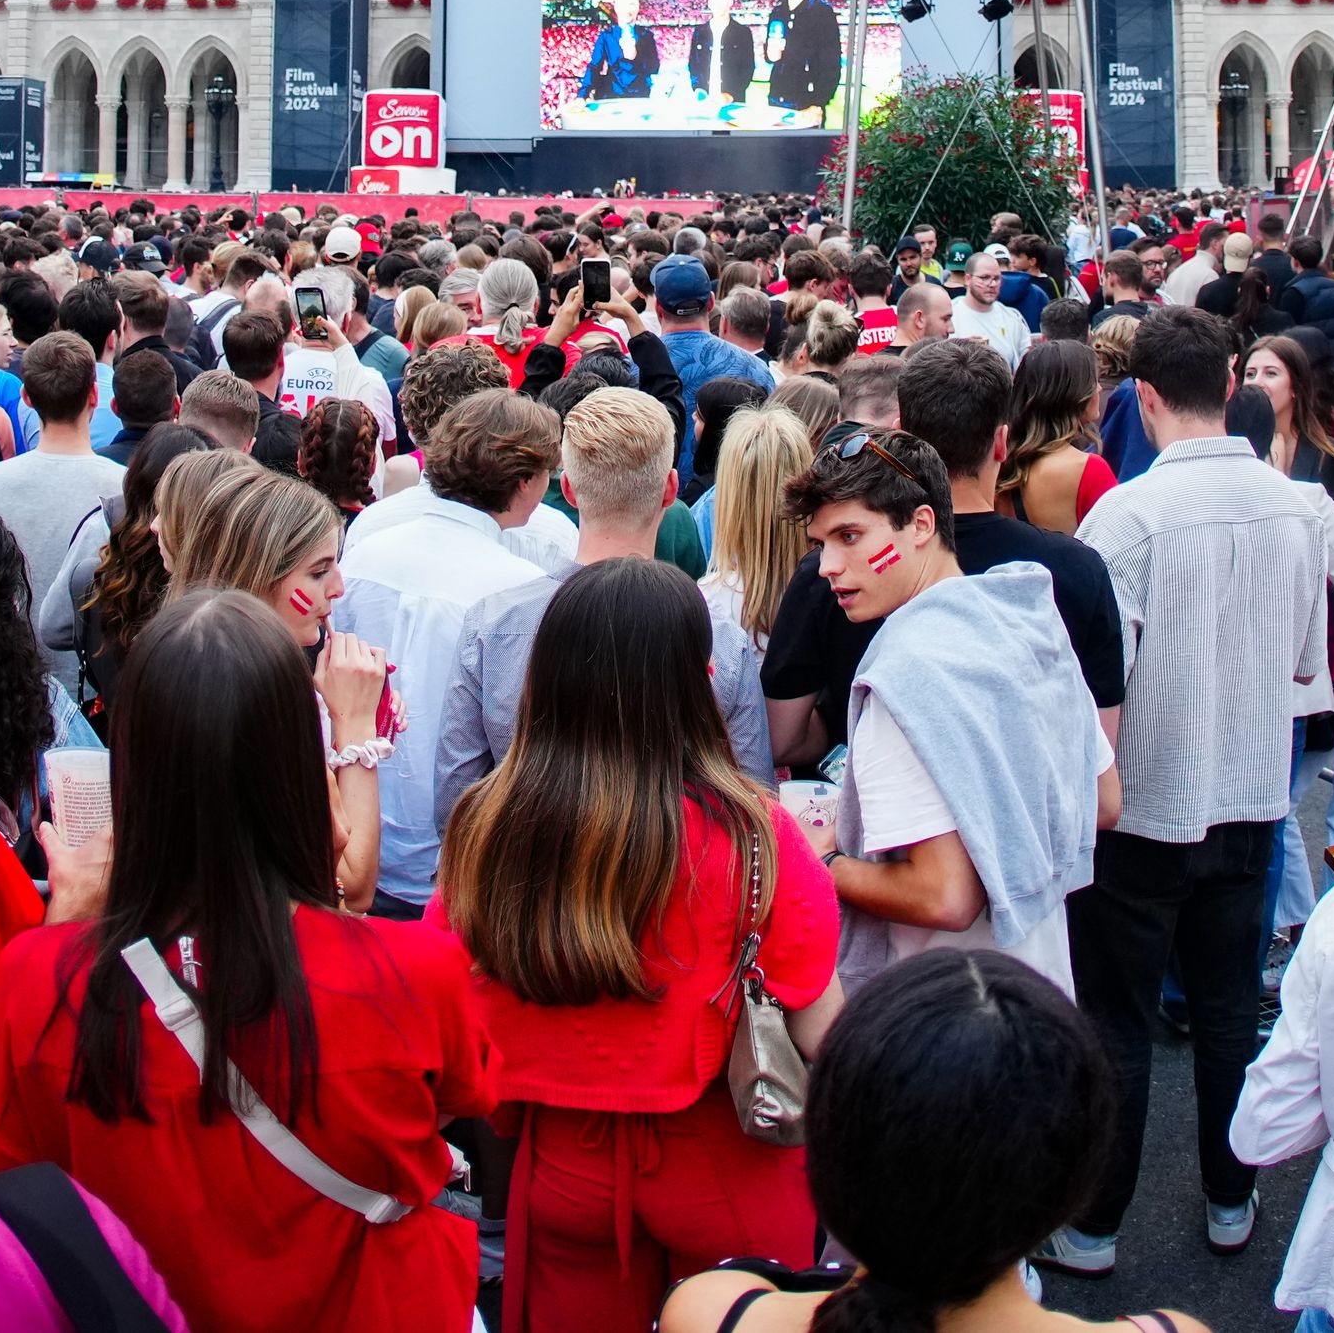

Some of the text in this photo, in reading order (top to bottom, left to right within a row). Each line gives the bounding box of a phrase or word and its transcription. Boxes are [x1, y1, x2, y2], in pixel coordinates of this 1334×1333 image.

[285, 68, 315, 82] Film
[1109, 63, 1139, 76] Film
[284, 82, 338, 96] Festival
[1109, 77, 1162, 91] Festival
[284, 98, 320, 111] 2024
[1109, 93, 1145, 106] 2024
[369, 125, 433, 159] on
[308, 368, 333, 379] UEFA
